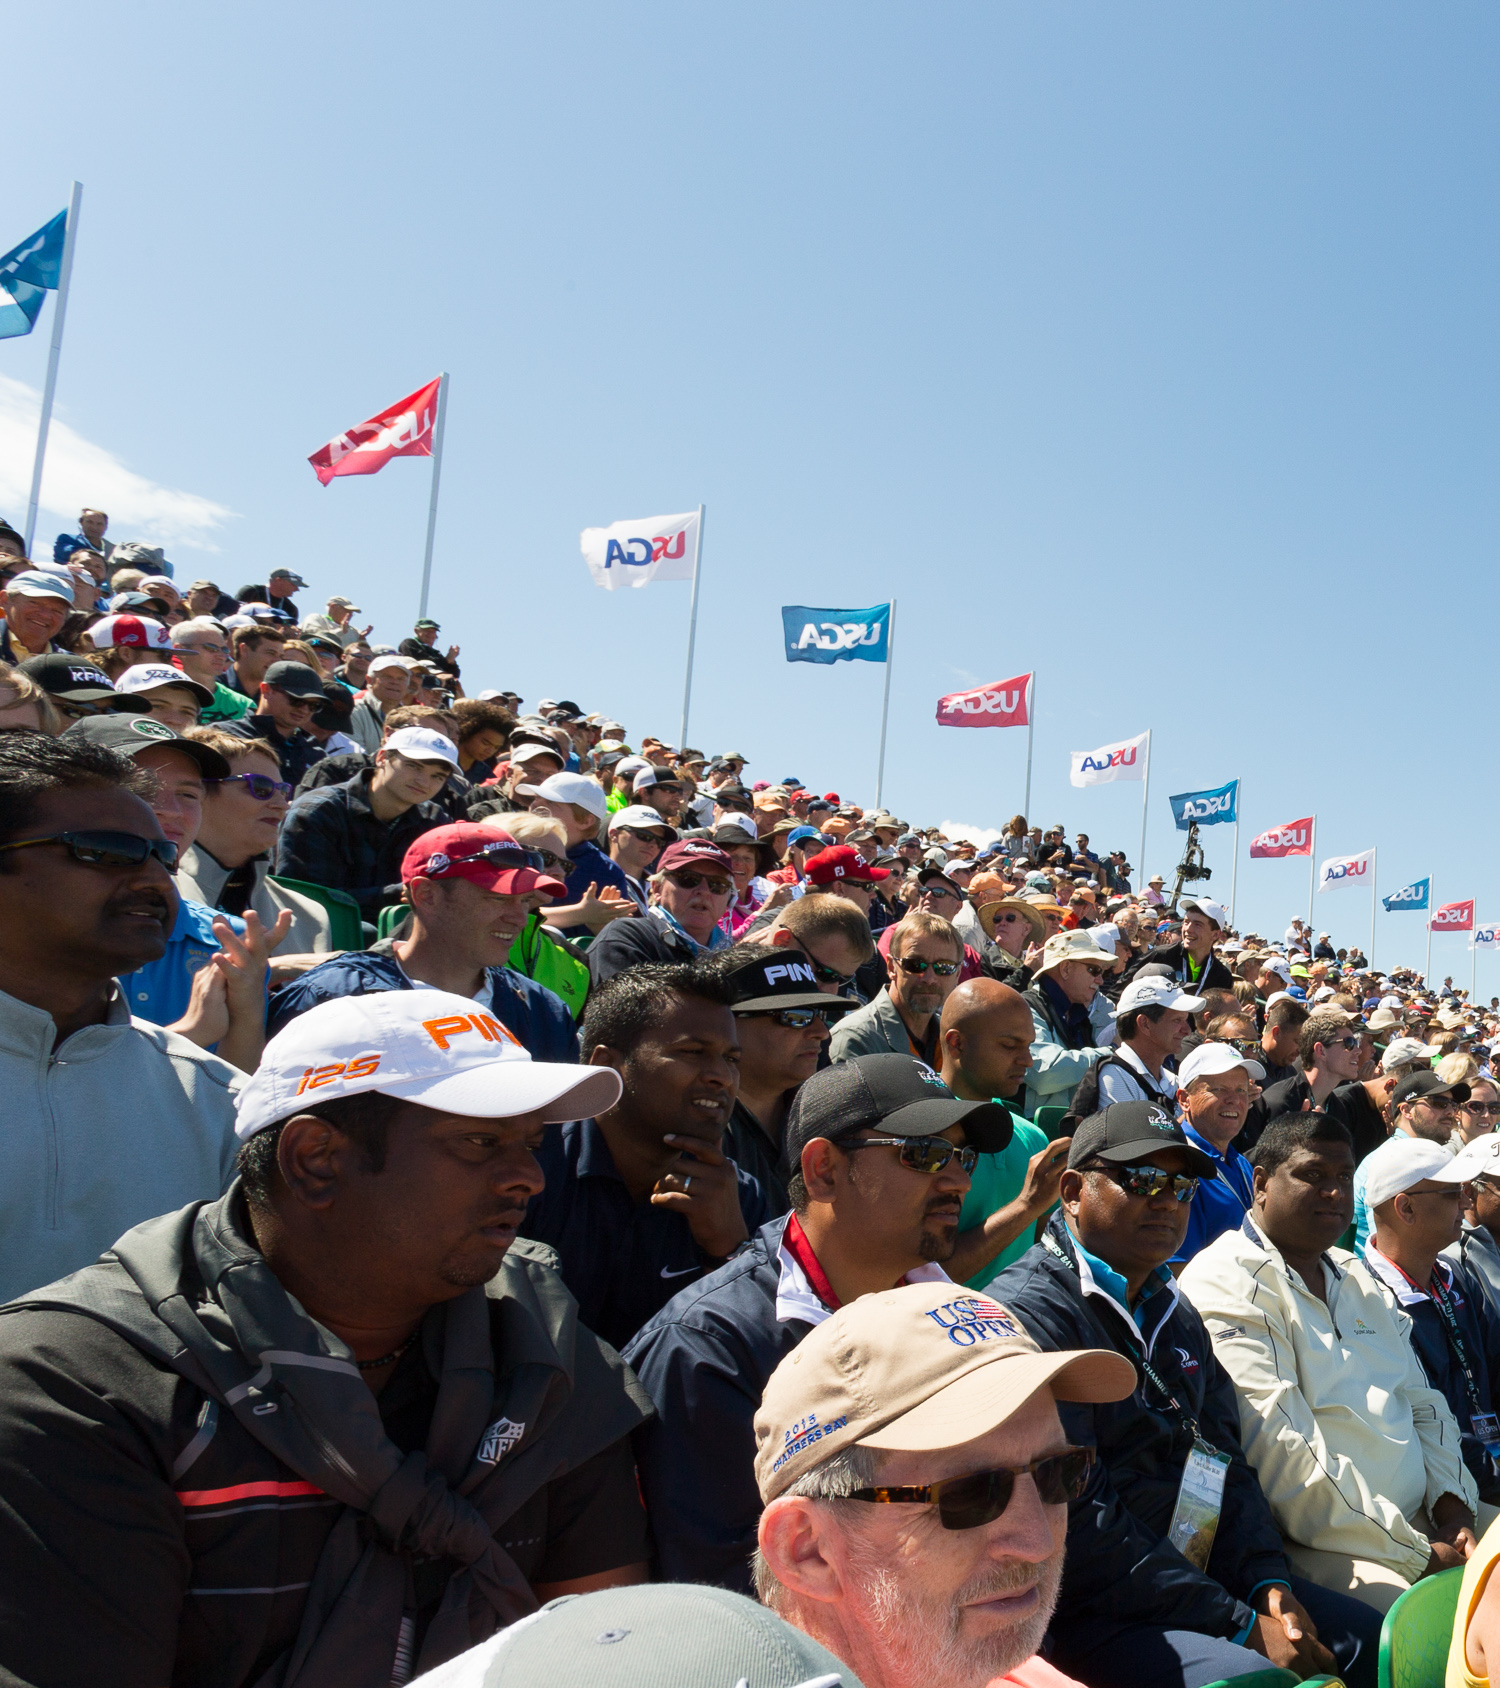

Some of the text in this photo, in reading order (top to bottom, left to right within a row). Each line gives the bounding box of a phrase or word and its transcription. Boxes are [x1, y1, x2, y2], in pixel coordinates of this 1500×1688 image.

[483, 841, 522, 851] MERC
[422, 1014, 522, 1050] PIN
[1060, 1255, 1074, 1269] BAY
[948, 1320, 1021, 1346] OPEN
[1449, 1315, 1458, 1328] 2015
[785, 1413, 816, 1441] 2015
[773, 1414, 847, 1473] CHAMBERS BAY
